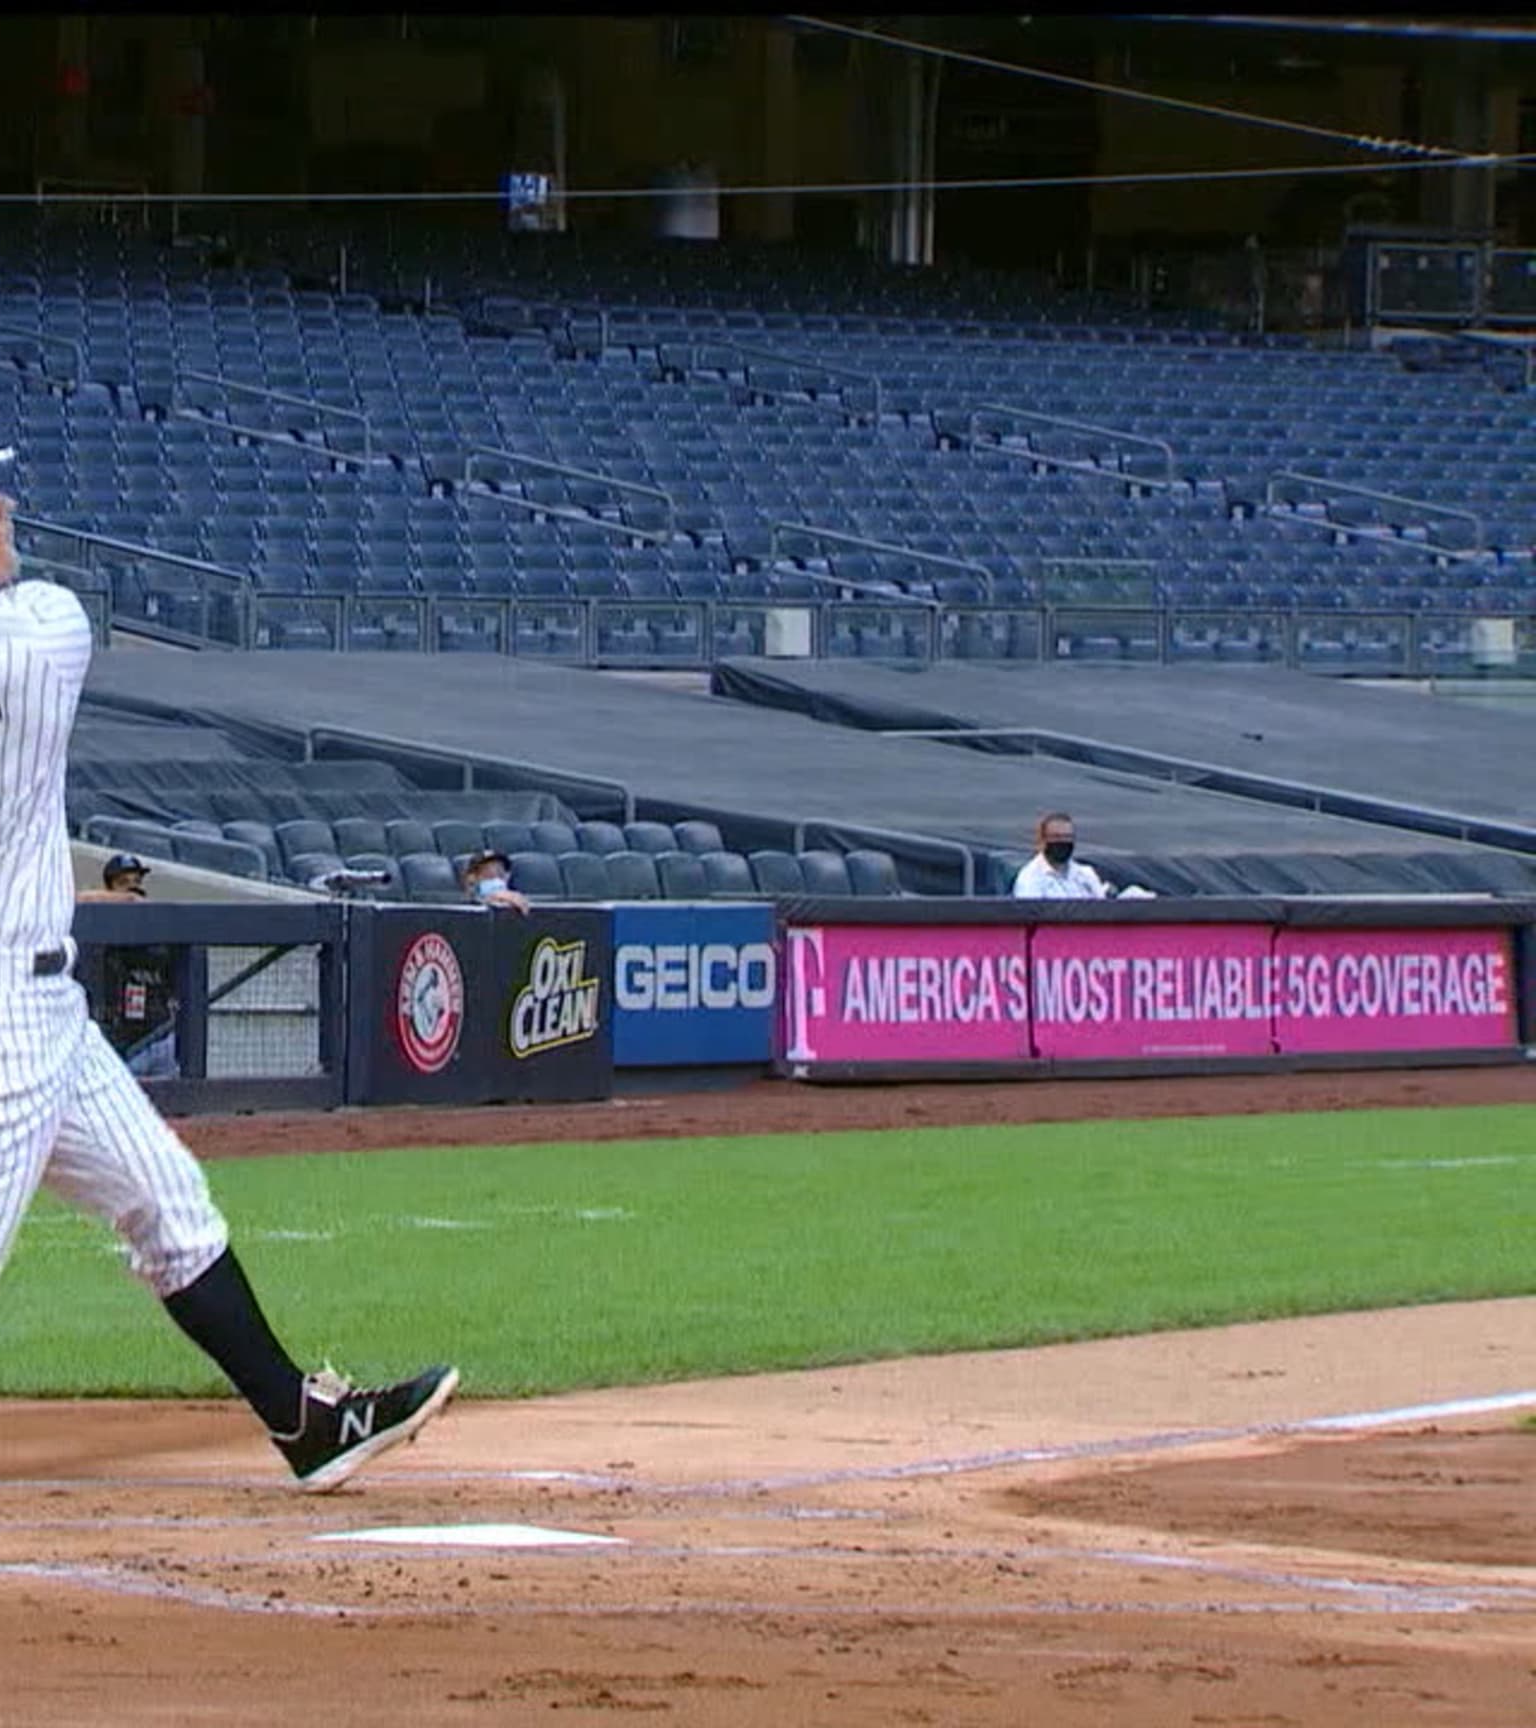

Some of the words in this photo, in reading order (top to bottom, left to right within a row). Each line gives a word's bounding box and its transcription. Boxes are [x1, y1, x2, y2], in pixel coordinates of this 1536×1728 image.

[533, 944, 583, 1000] OXI
[616, 943, 776, 1009] GEICO
[844, 955, 1029, 1023] AMERICA'S
[1034, 957, 1126, 1023] MOST
[1132, 956, 1282, 1021] RELIABLE
[1288, 955, 1332, 1019] 5G
[1336, 953, 1508, 1018] COVERAGE
[515, 985, 596, 1050] CLEAN
